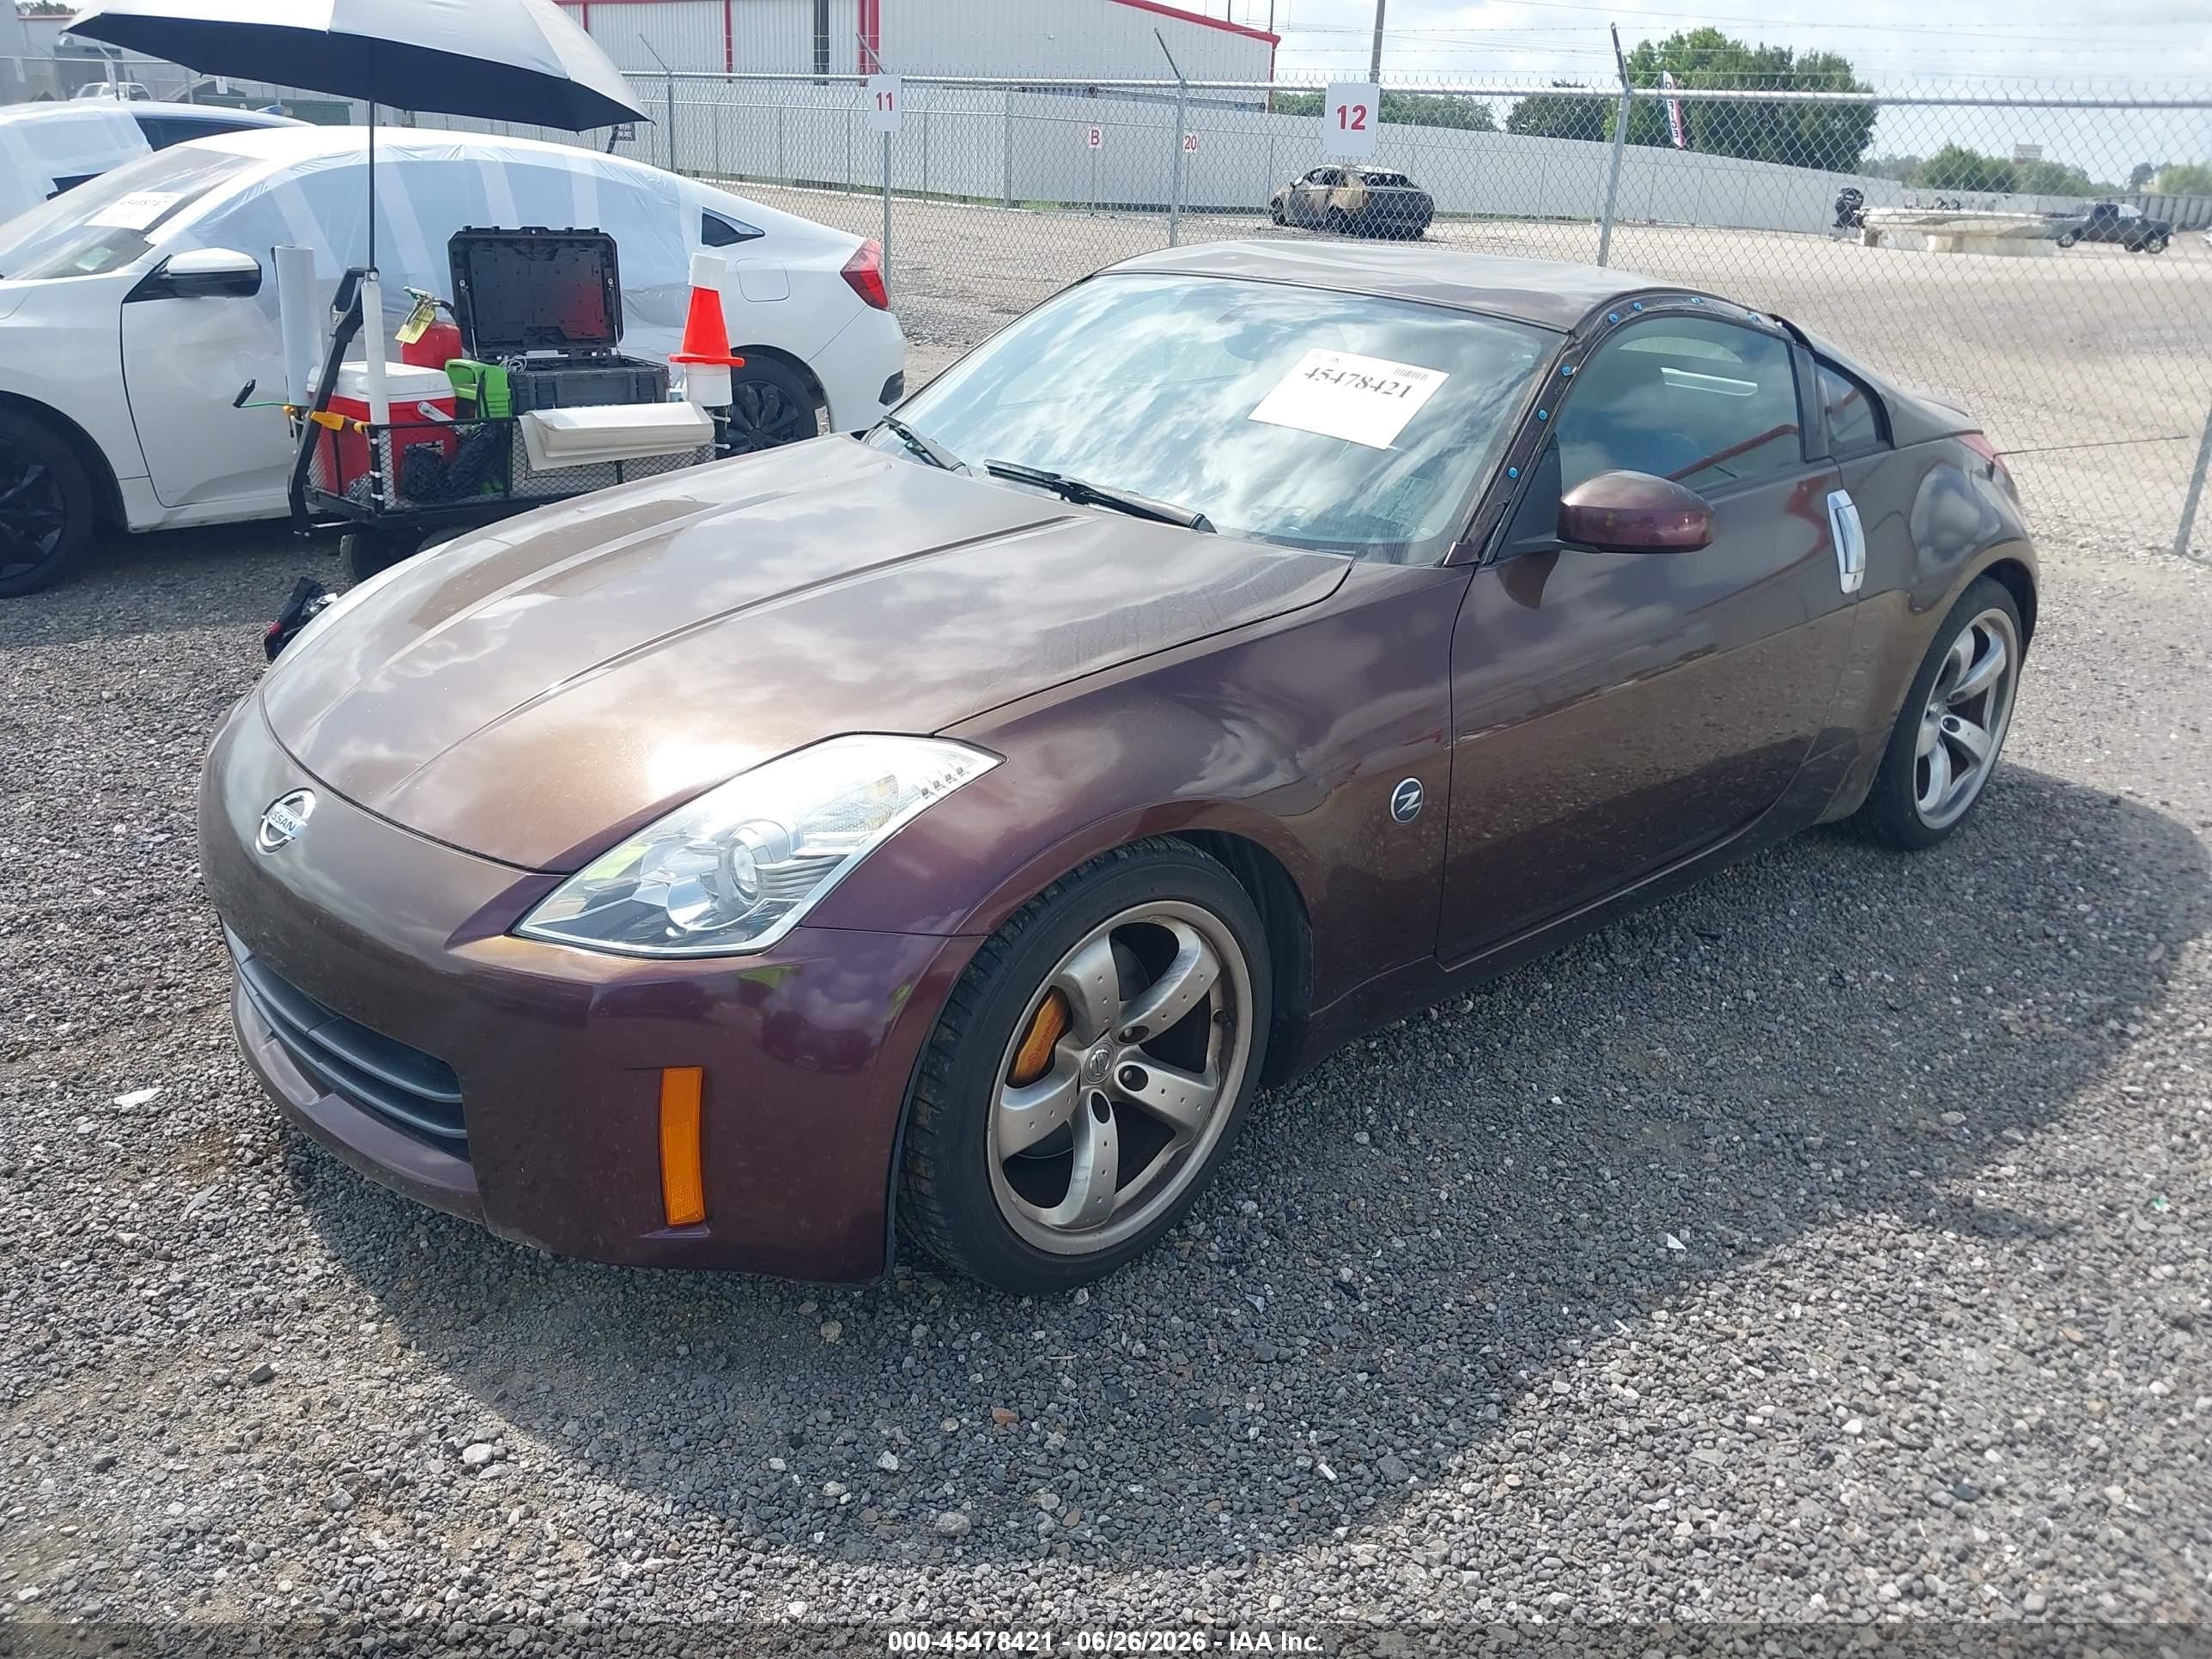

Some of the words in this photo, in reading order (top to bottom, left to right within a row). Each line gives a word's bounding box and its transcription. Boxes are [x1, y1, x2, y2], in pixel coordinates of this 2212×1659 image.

[876, 92, 893, 112] 11
[1337, 105, 1366, 130] 12
[1091, 130, 1100, 145] B
[1184, 135, 1197, 150] 20
[1304, 367, 1413, 398] 45478421
[1396, 789, 1421, 814] Z
